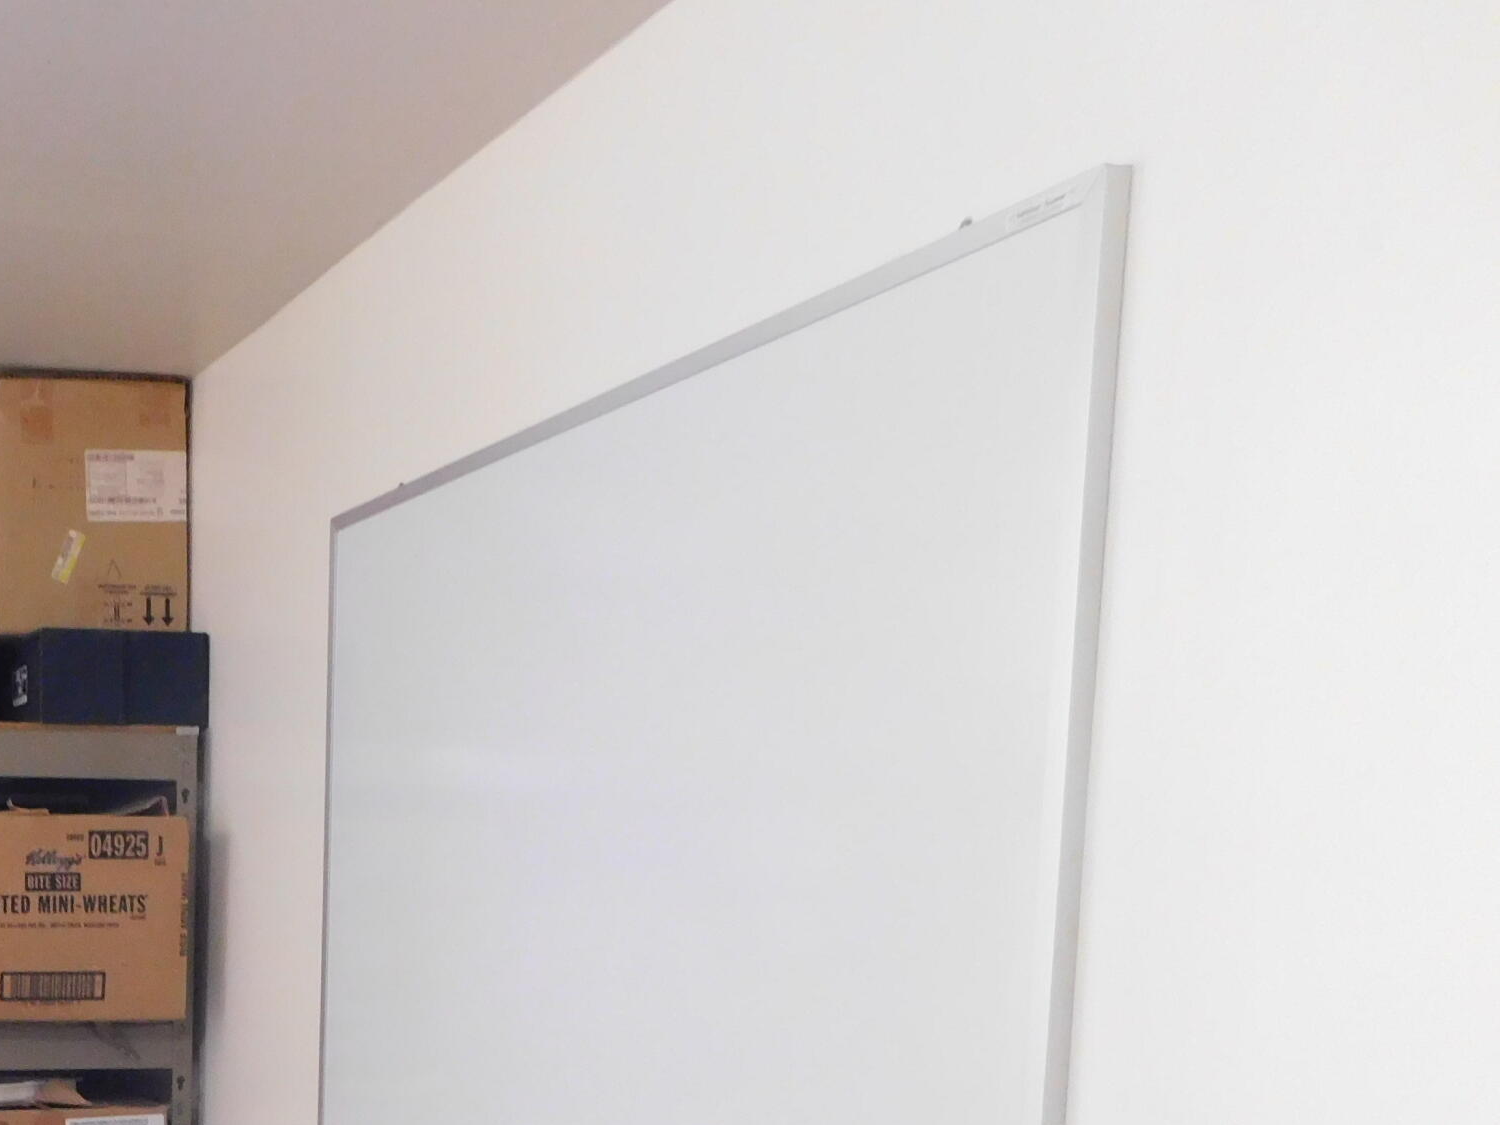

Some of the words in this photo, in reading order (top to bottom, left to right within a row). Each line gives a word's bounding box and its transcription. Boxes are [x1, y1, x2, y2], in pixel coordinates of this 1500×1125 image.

[89, 833, 148, 858] 04925
[26, 874, 51, 890] BITE
[55, 874, 80, 890] SIZE
[37, 894, 147, 914] MINI-WHEATS
